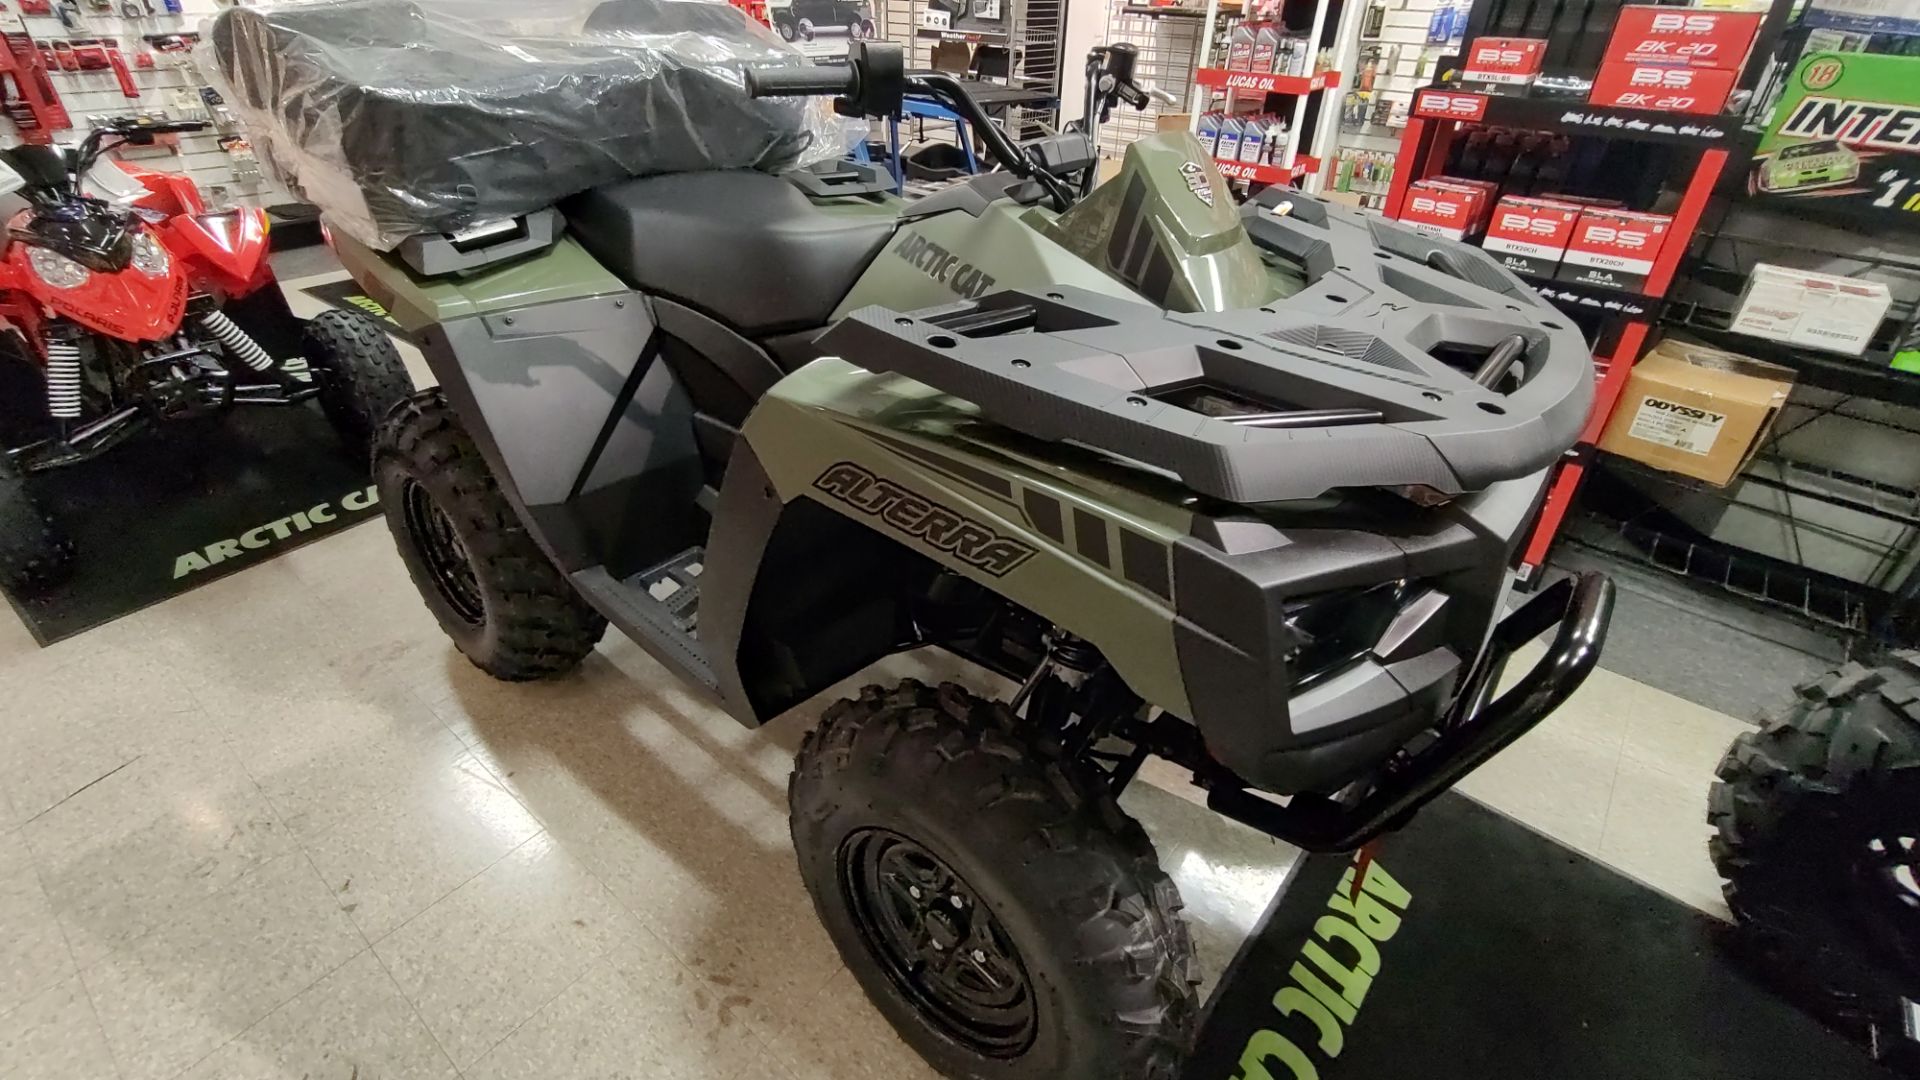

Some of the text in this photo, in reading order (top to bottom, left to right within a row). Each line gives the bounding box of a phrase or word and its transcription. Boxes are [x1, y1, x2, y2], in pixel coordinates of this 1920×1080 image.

[1652, 13, 1717, 31] BS
[1476, 48, 1525, 63] BS
[1635, 40, 1718, 56] BK 20
[1225, 74, 1276, 90] LUCAS OIL
[1631, 67, 1696, 86] BS
[1807, 62, 1842, 85] 18
[1420, 94, 1481, 112] BS
[1615, 92, 1696, 109] BK 20
[1780, 97, 1920, 146] INTE
[1241, 167, 1258, 178] OIL
[1412, 197, 1460, 215] BS
[1502, 213, 1560, 233] BS
[1585, 226, 1648, 246] BS
[1505, 243, 1538, 254] BTX20CH
[893, 231, 996, 299] ARCTIC CAT
[1589, 257, 1624, 267] BTX20CH
[50, 296, 126, 335] POLARIS
[812, 461, 1040, 578] ALTERRA
[173, 502, 338, 580] ARCTIC
[1272, 849, 1413, 1059] ARCTIC
